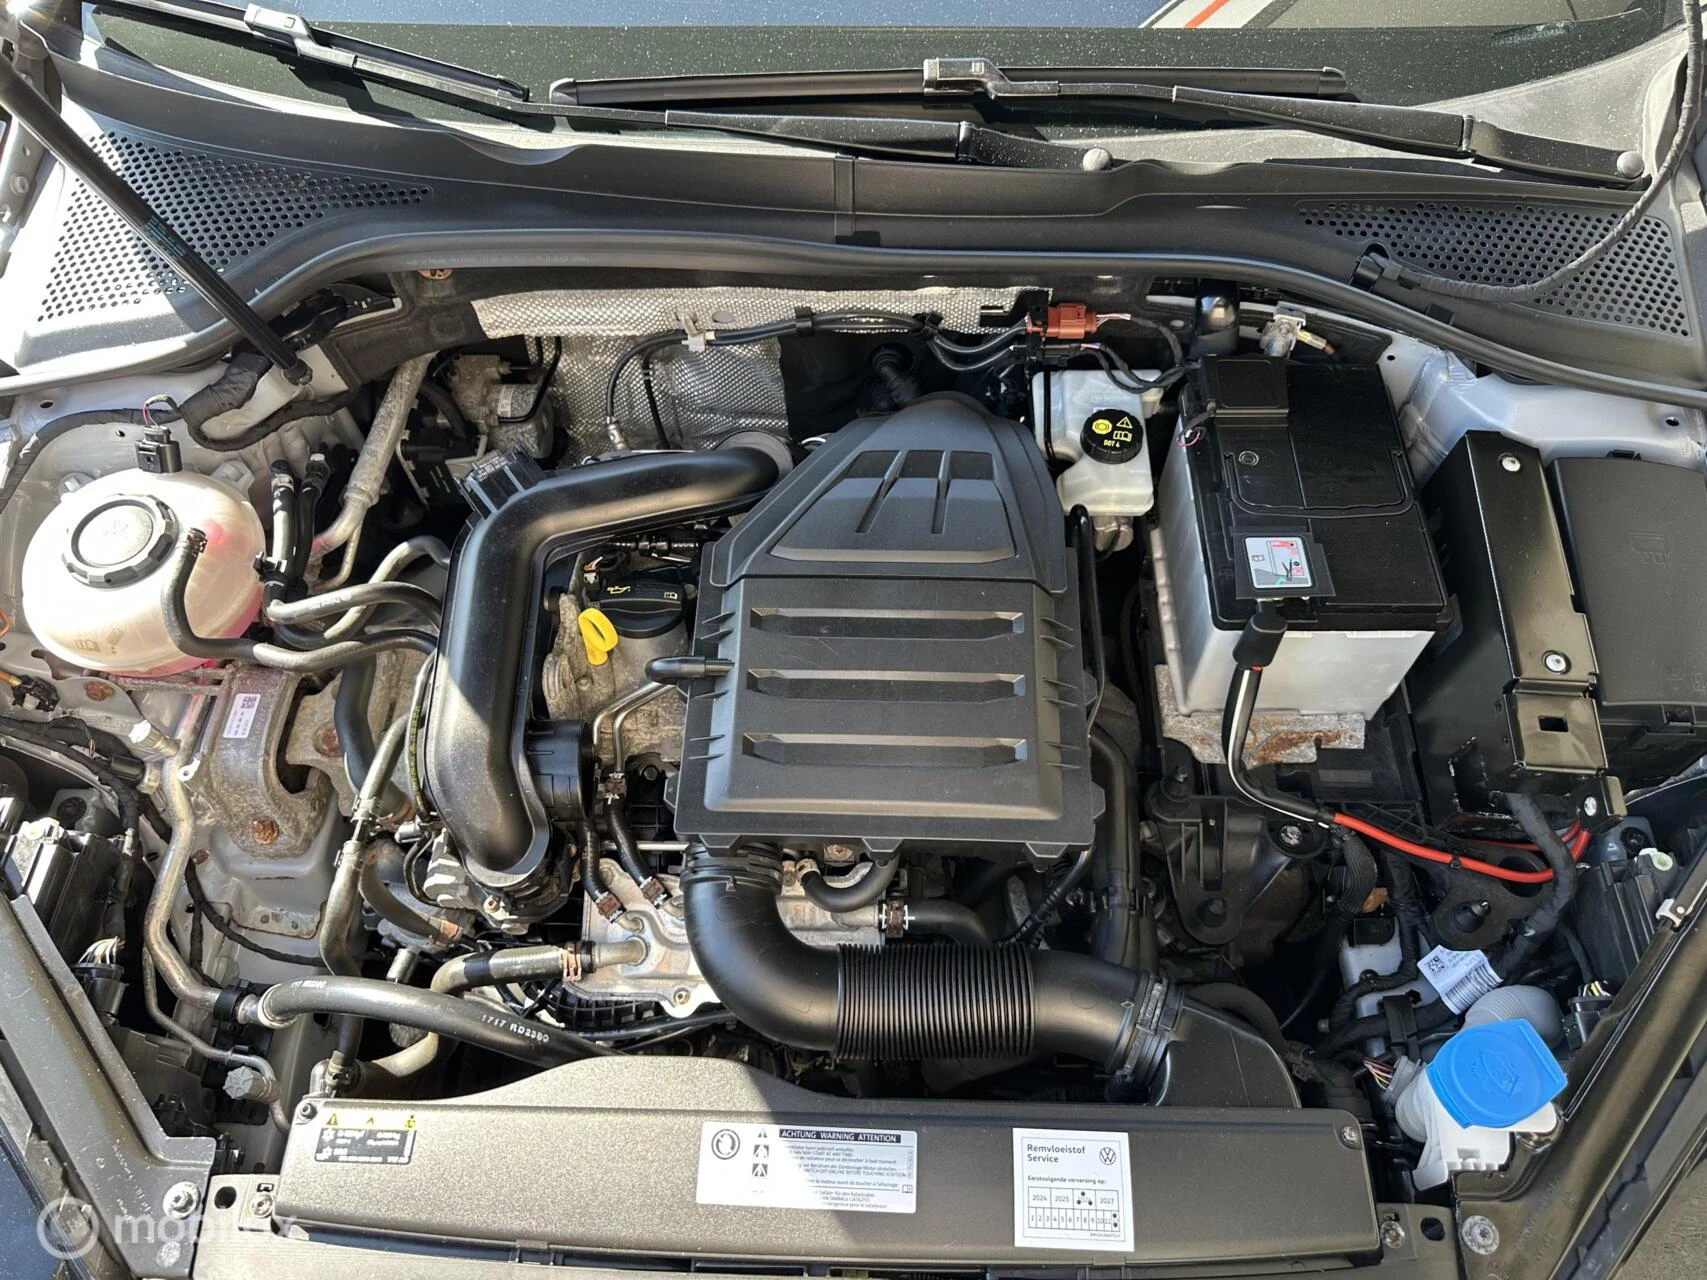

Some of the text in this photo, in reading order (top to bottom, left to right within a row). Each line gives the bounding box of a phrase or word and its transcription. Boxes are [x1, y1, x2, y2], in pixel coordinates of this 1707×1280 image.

[781, 1130, 897, 1142] ACHTUNG WARNING ATTENTION
[1027, 1144, 1086, 1154] Remvloeistof
[1027, 1154, 1059, 1163] Service
